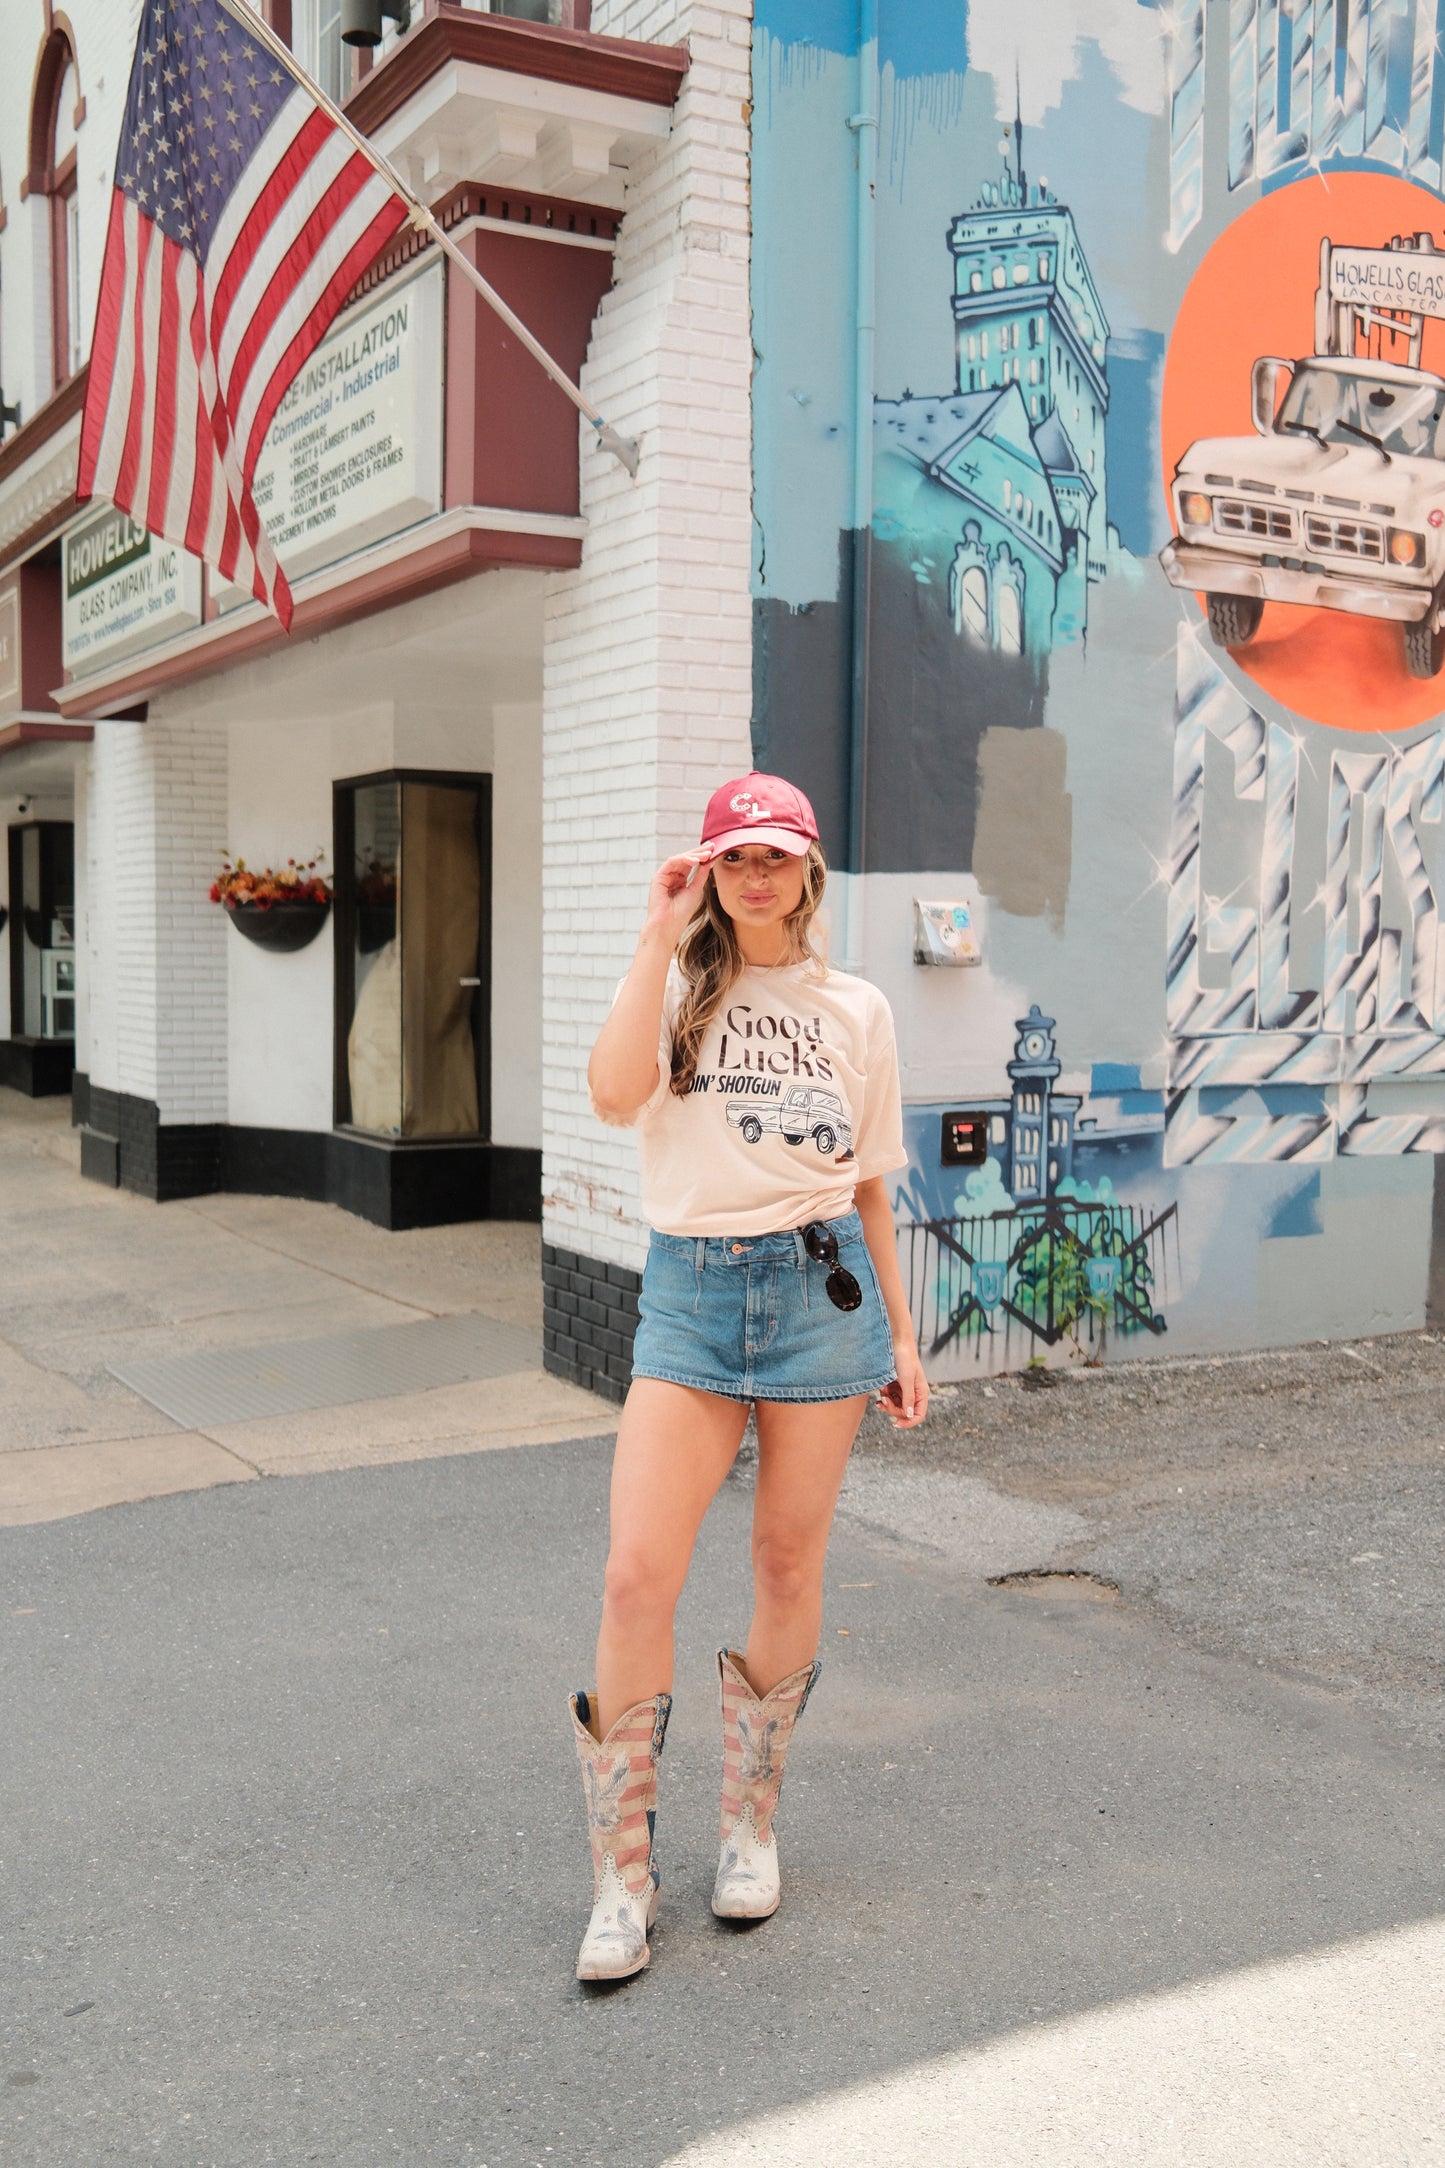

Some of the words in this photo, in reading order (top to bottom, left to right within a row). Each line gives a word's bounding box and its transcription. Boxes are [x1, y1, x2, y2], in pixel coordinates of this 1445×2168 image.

[1335, 261, 1404, 290] HOWELLS
[1407, 271, 1445, 300] GLAS
[1343, 286, 1437, 312] LANCASTER
[306, 304, 408, 397] INSTALLATION
[272, 391, 332, 446] Commercial
[343, 346, 400, 400] Industrial
[293, 424, 327, 452] HARDWARE
[320, 426, 350, 456] LAMBERT
[351, 410, 376, 437] PAINTS
[341, 467, 365, 494] DOORS
[373, 447, 404, 476] FRAMES
[347, 435, 393, 474] ENCLOSURES
[70, 516, 147, 585] HOWELLS
[80, 590, 105, 624] GLASS
[158, 549, 178, 584] INC.
[727, 1005, 824, 1044] Good
[717, 1075, 782, 1097] SHOTGUN
